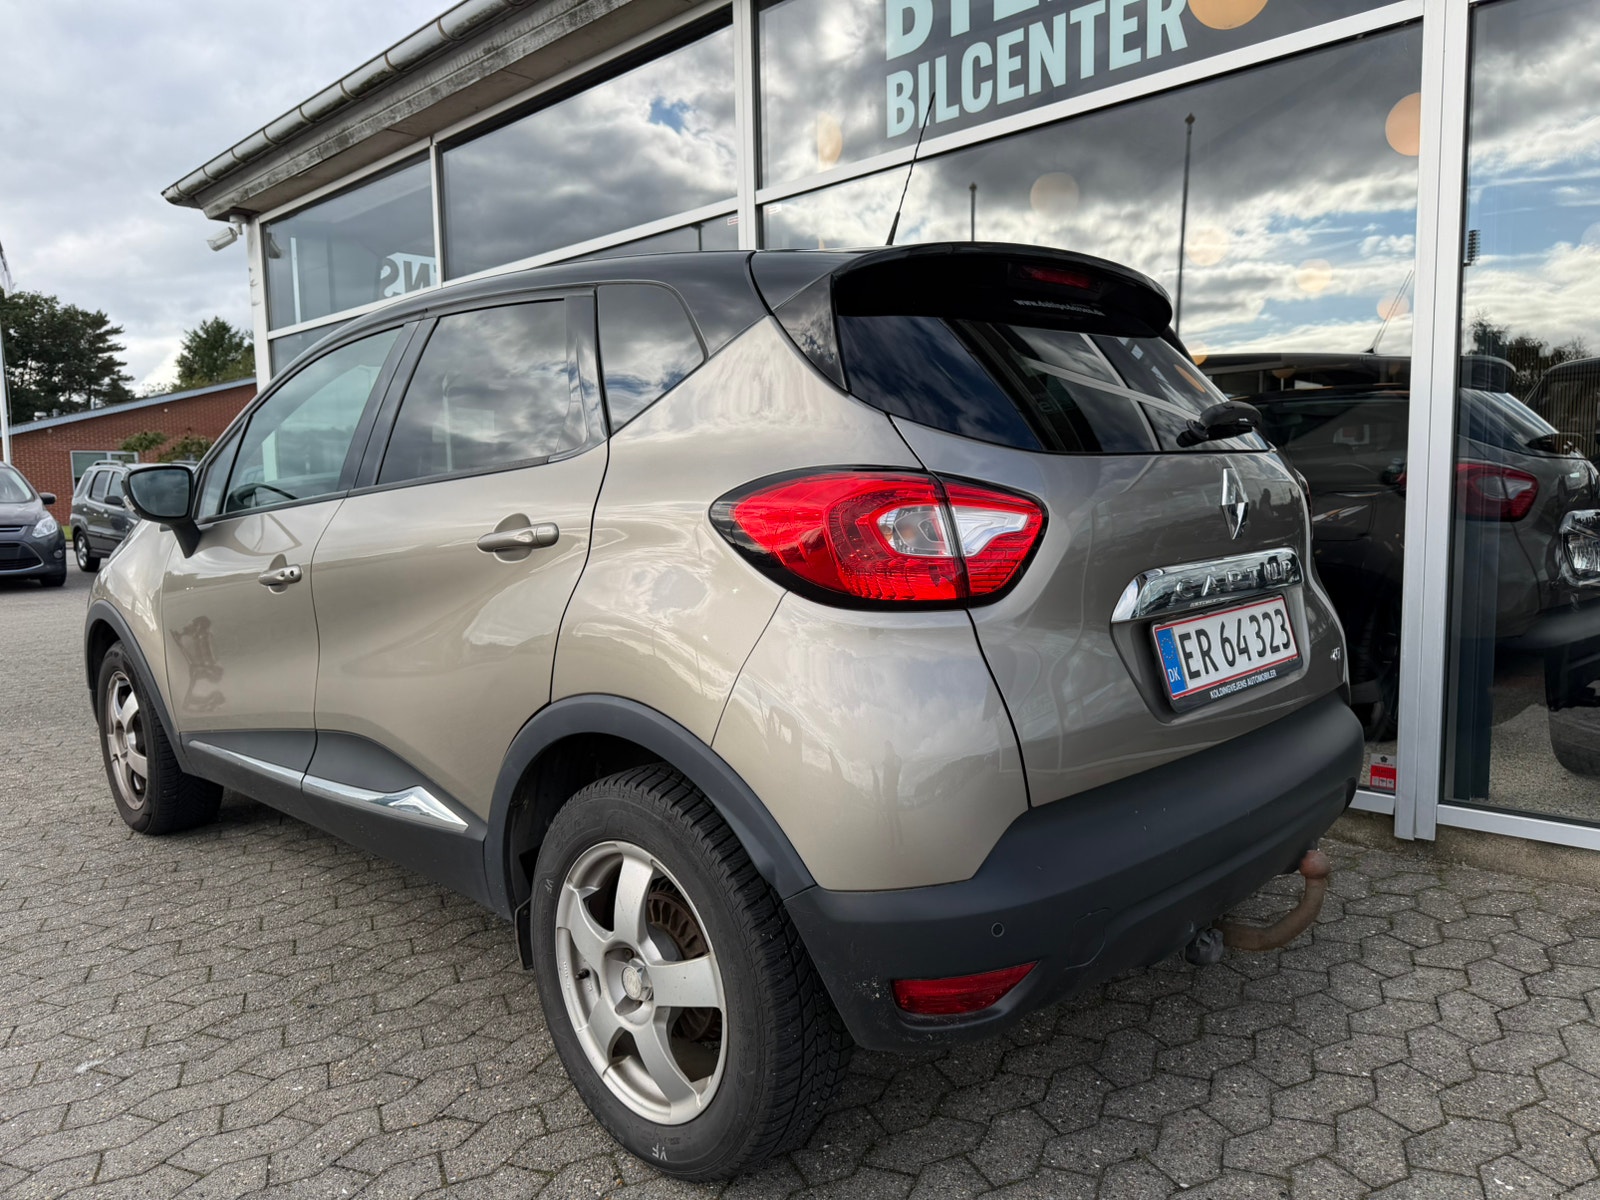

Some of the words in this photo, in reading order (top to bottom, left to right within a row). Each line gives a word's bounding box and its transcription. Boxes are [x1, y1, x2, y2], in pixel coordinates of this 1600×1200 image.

[886, 0, 1188, 138] BILCENTER
[1178, 628, 1219, 680] ER
[1168, 667, 1181, 683] DK
[1247, 670, 1277, 686] AUTOMOBILER
